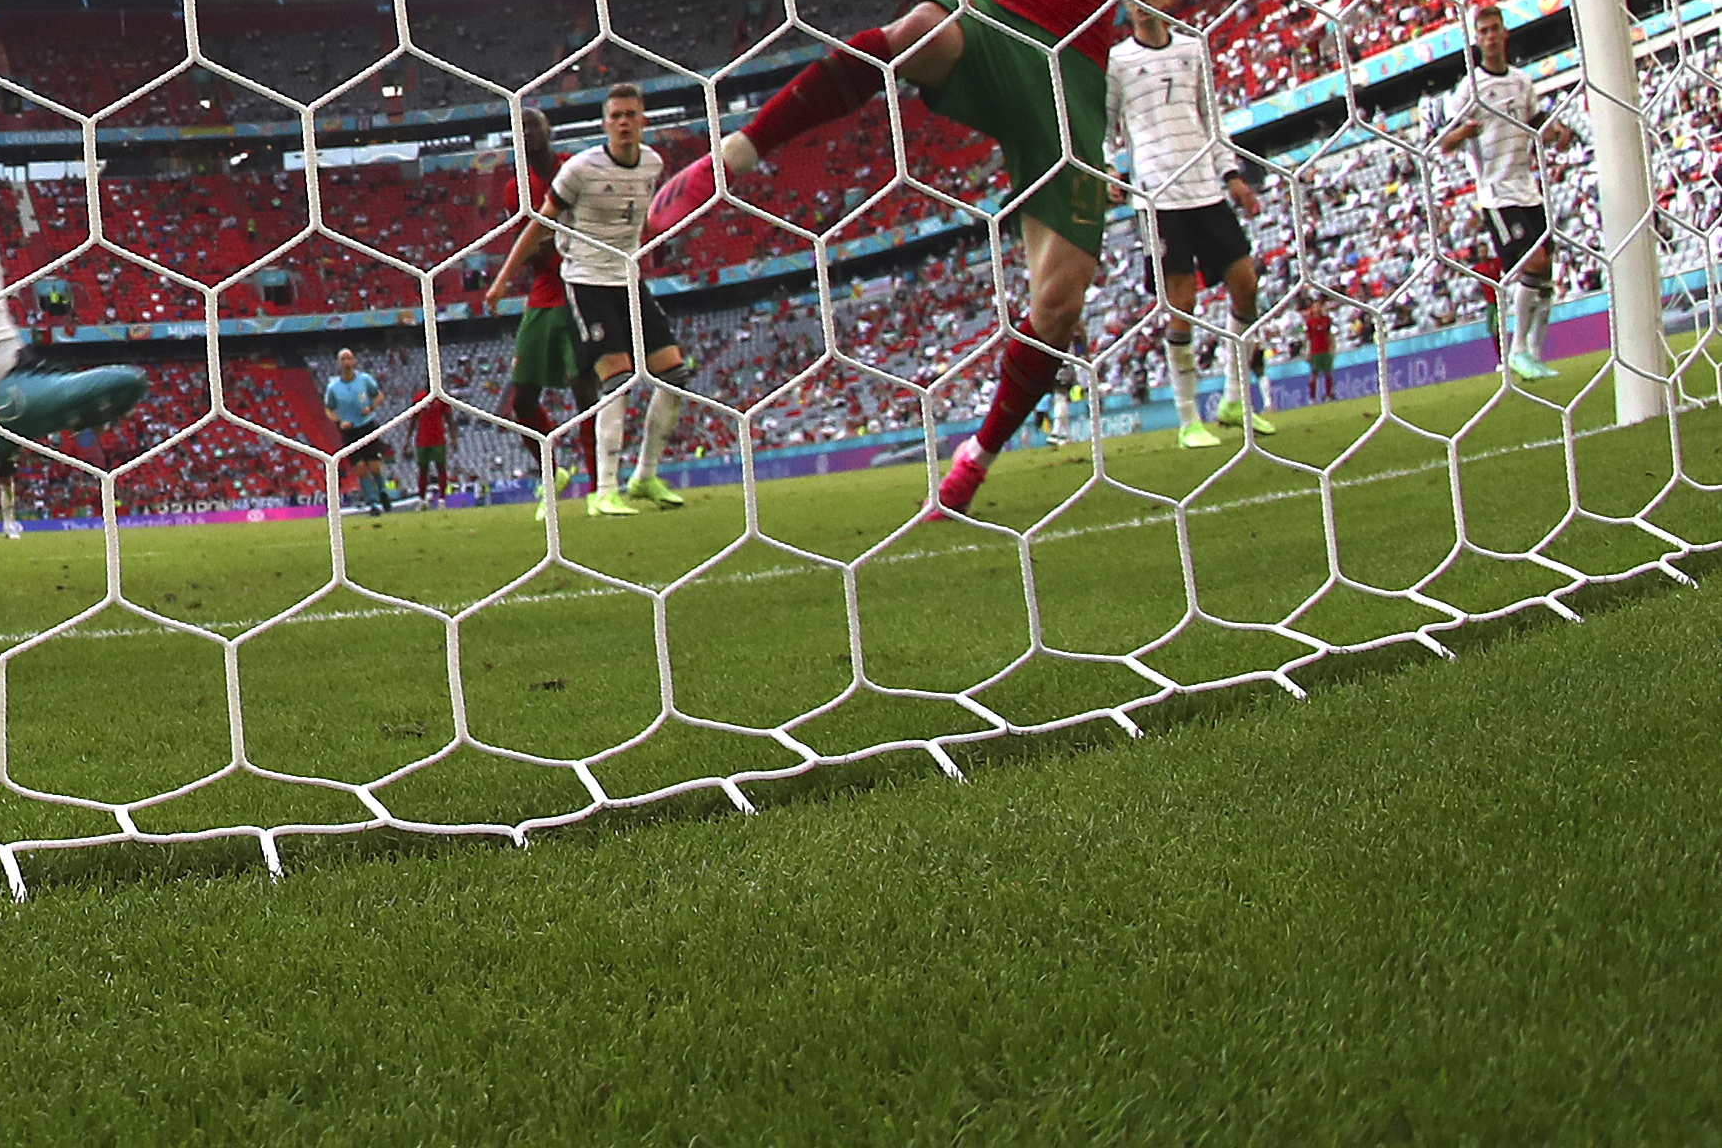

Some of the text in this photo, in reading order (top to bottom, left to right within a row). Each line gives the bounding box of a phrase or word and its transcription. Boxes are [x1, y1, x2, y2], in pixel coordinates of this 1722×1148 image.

[1160, 77, 1172, 103] 7
[620, 200, 634, 225] 4
[1408, 356, 1446, 387] ID.4
